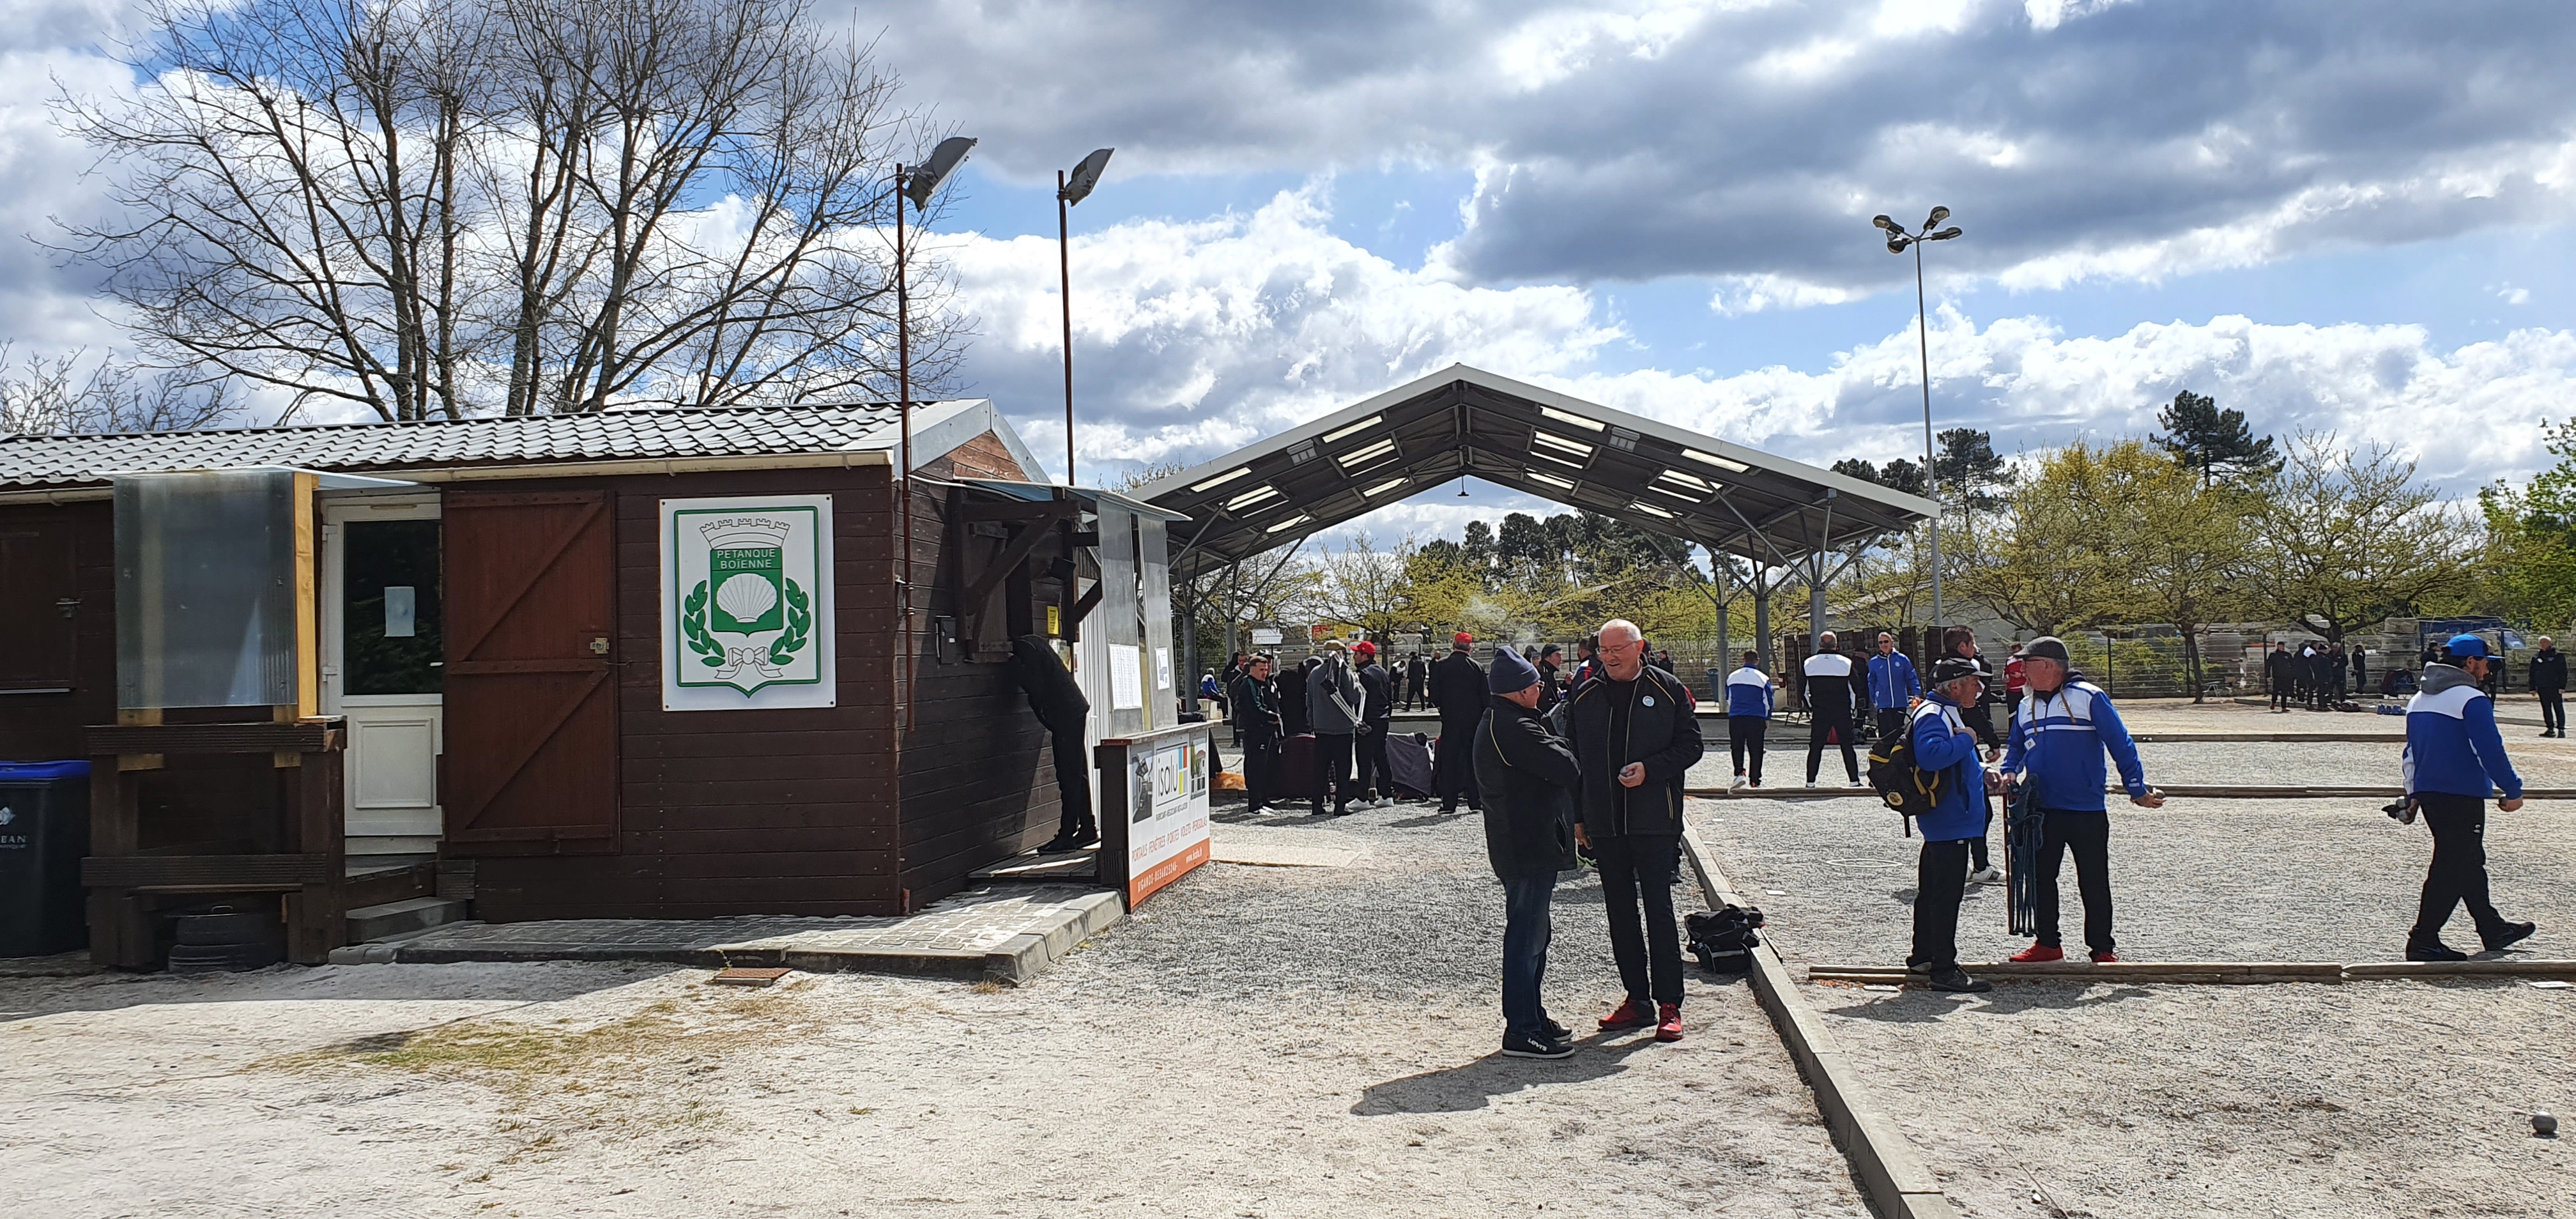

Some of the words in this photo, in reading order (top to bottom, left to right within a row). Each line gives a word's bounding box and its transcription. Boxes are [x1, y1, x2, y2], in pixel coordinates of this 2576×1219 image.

[717, 549, 776, 558] PETANQUE
[721, 559, 772, 569] BOÏENNE
[1158, 755, 1178, 797] isalu
